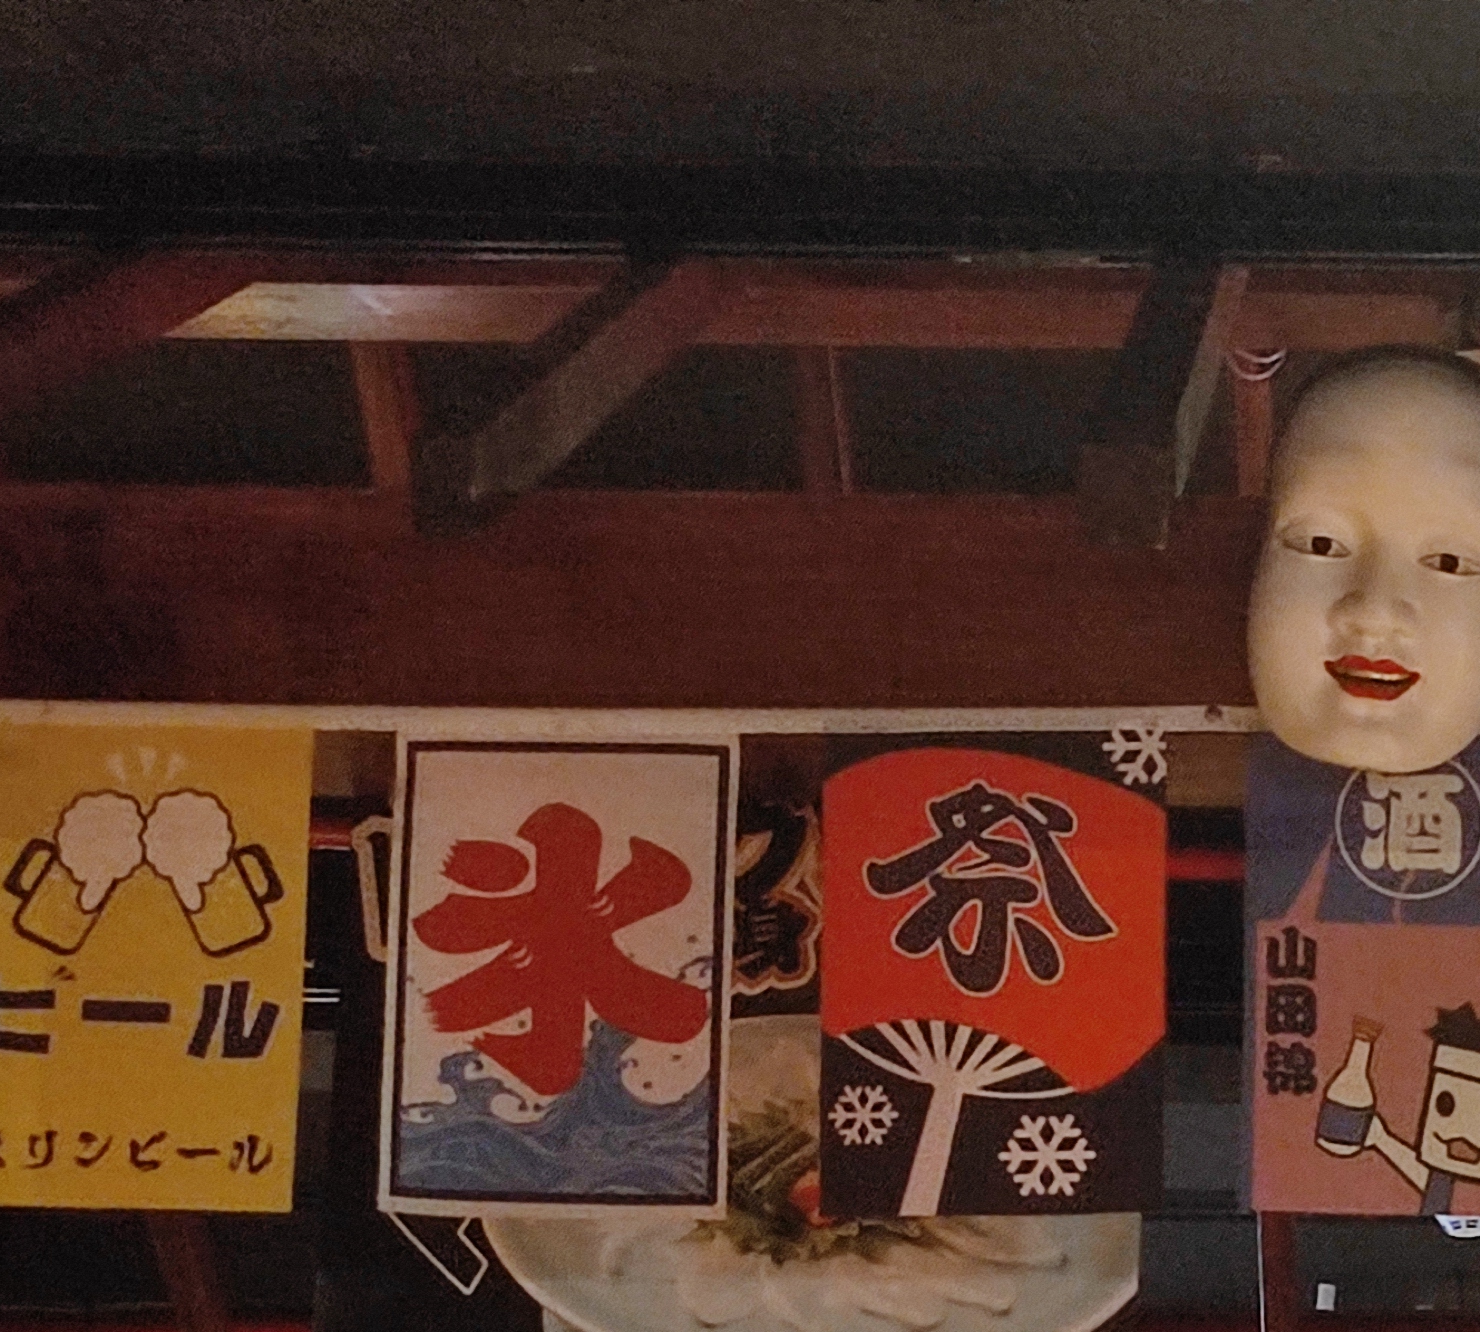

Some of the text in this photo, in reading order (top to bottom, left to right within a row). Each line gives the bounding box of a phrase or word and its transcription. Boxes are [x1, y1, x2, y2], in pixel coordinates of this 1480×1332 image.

[862, 778, 1120, 998] 祭
[1359, 770, 1469, 876] 酒
[411, 801, 710, 1096] 氷
